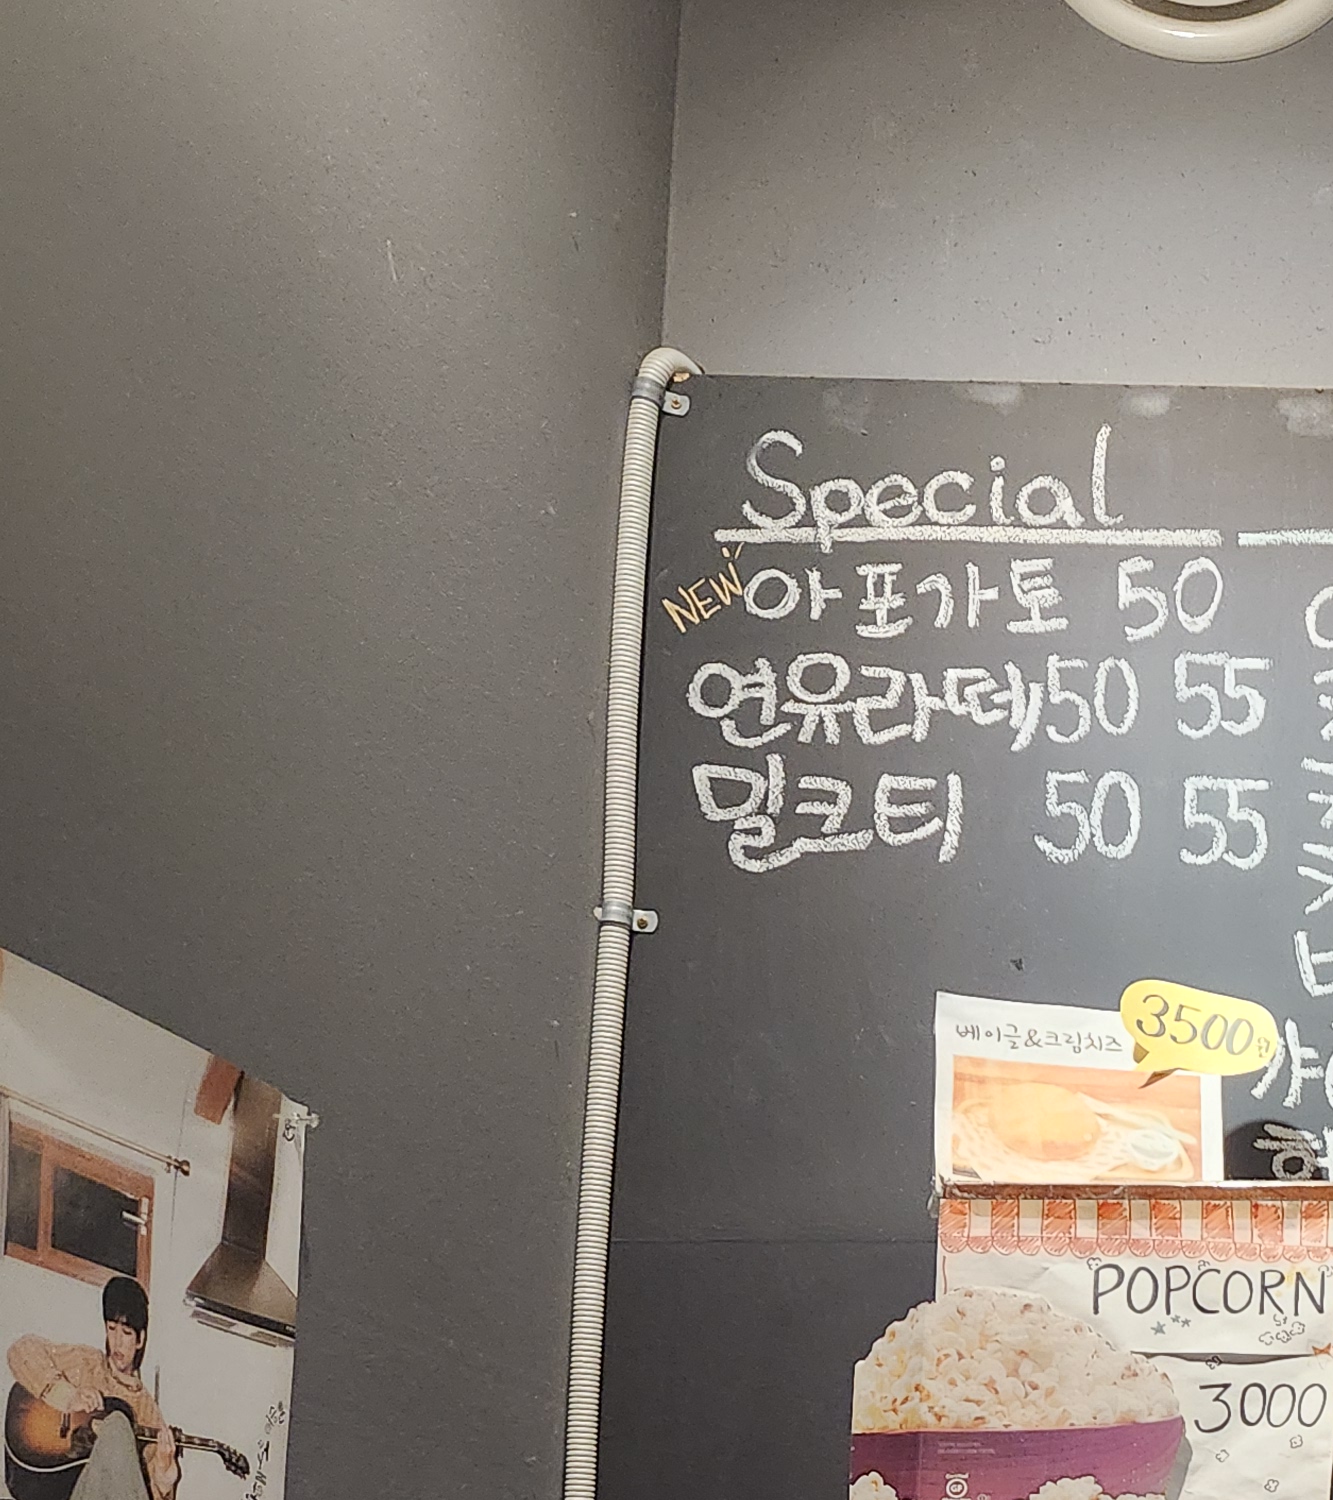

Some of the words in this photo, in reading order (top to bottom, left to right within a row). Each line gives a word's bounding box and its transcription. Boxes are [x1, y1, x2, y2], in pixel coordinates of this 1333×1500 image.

[742, 424, 1124, 552] Special
[662, 558, 745, 633] NEW
[743, 557, 1068, 638] 아포가토
[1117, 556, 1223, 641] 50
[686, 652, 1044, 752] 연유라떼
[1046, 652, 1140, 744] 50
[1174, 651, 1273, 740] 55
[692, 752, 963, 875] 밀크티
[1035, 769, 1141, 865] 50
[1180, 774, 1271, 870] 55
[955, 1022, 1124, 1054] 베이글&크림치즈
[1092, 1261, 1327, 1317] POPCORN
[1193, 1381, 1327, 1434] 3000
